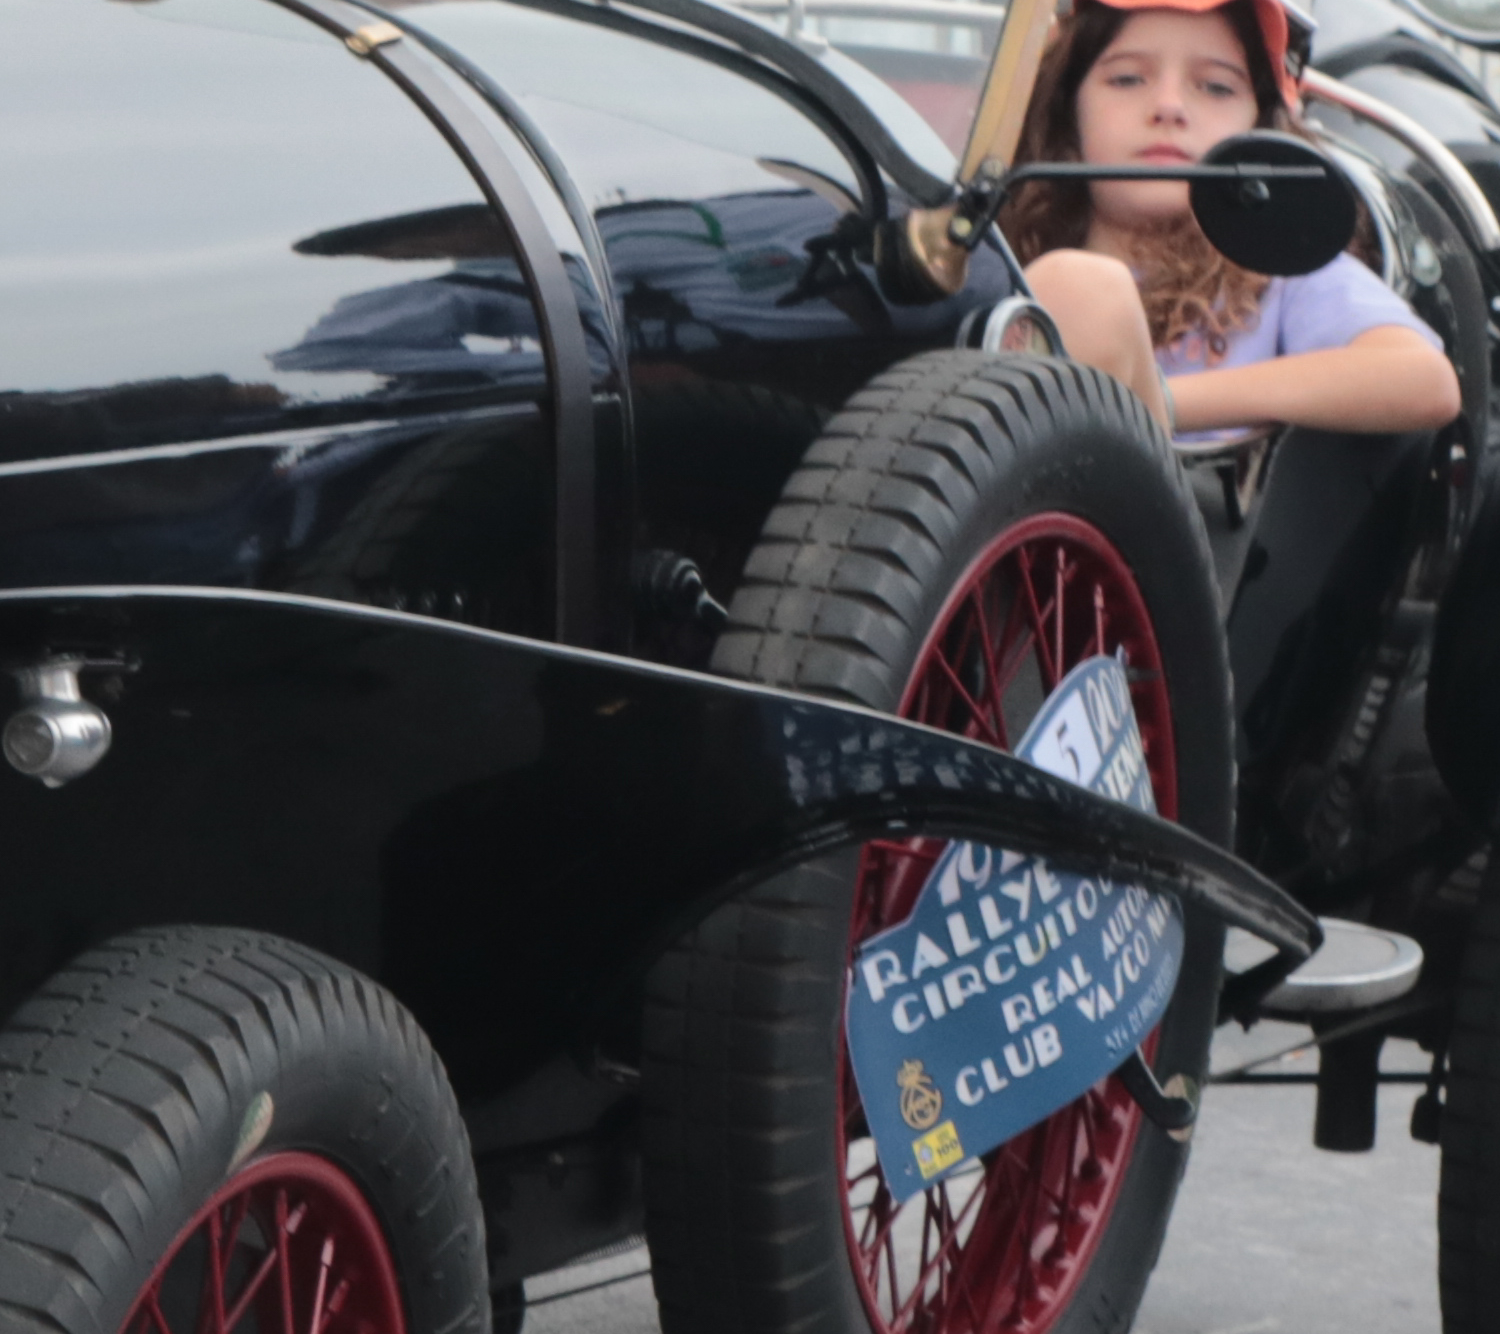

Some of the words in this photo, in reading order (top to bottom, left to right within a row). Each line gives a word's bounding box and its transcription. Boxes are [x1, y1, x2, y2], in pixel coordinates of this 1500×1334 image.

[862, 855, 1062, 1003] RALLYE
[892, 879, 1098, 1034] CIRCUITO
[1001, 953, 1093, 1034] REAL
[955, 1023, 1063, 1107] CLUB
